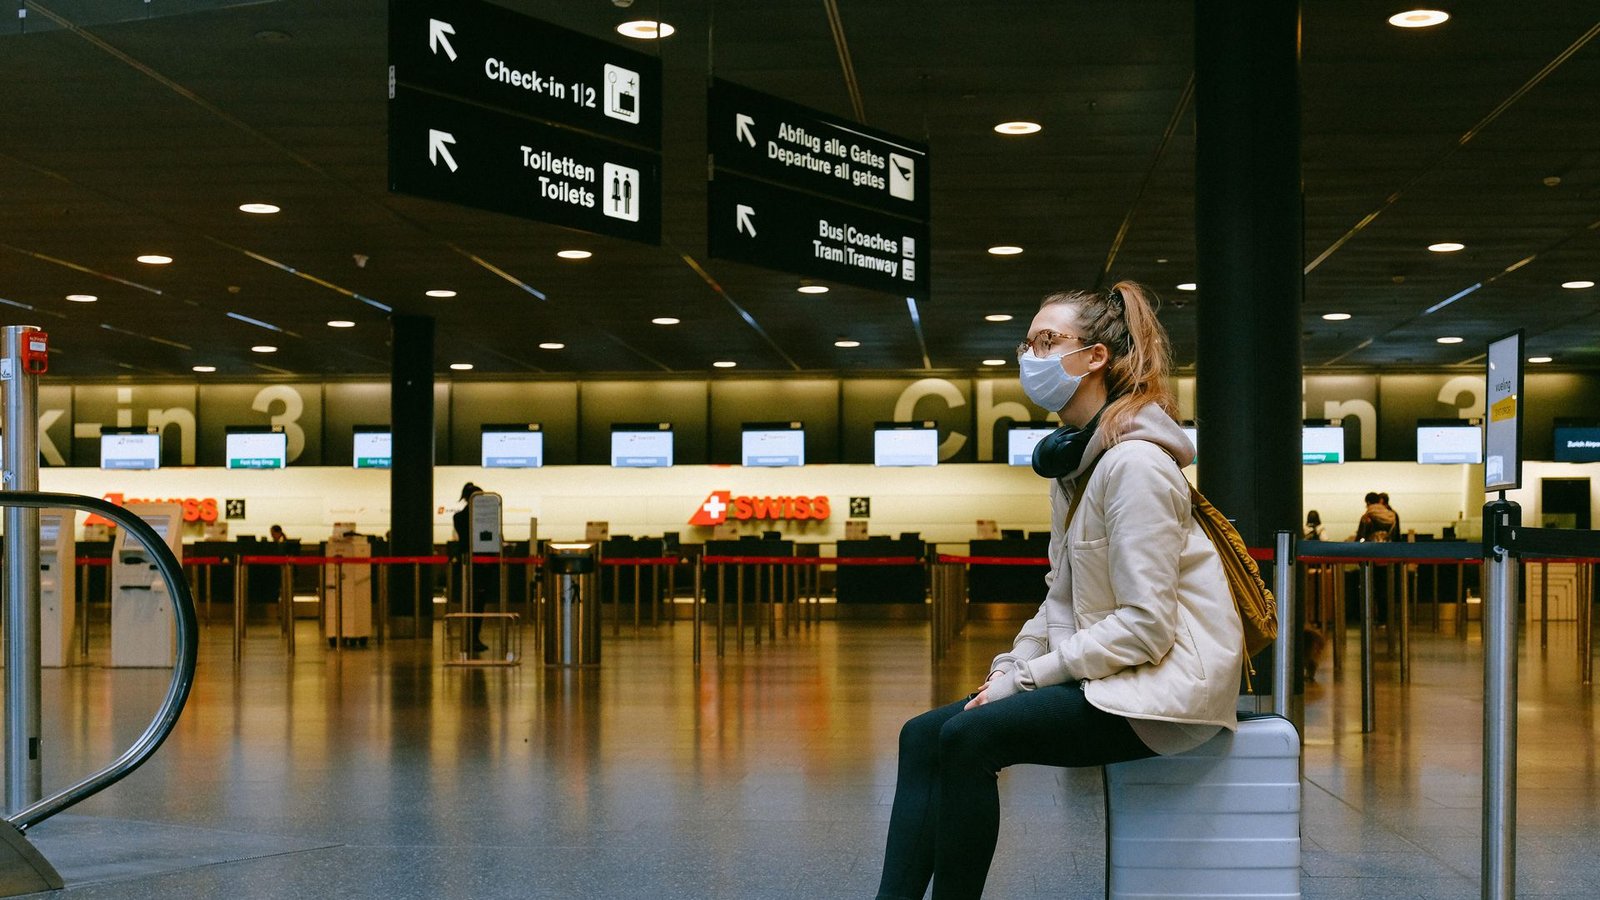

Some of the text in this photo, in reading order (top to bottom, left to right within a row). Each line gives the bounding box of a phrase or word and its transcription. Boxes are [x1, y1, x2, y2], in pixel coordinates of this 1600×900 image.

[485, 57, 565, 99] Check-in
[520, 145, 595, 183] Toiletten
[768, 141, 885, 190] Departure all gates
[778, 122, 885, 169] Abflug alle Gates
[538, 176, 595, 208] Toilets
[252, 385, 306, 464] 3
[734, 495, 832, 521] SWISS
